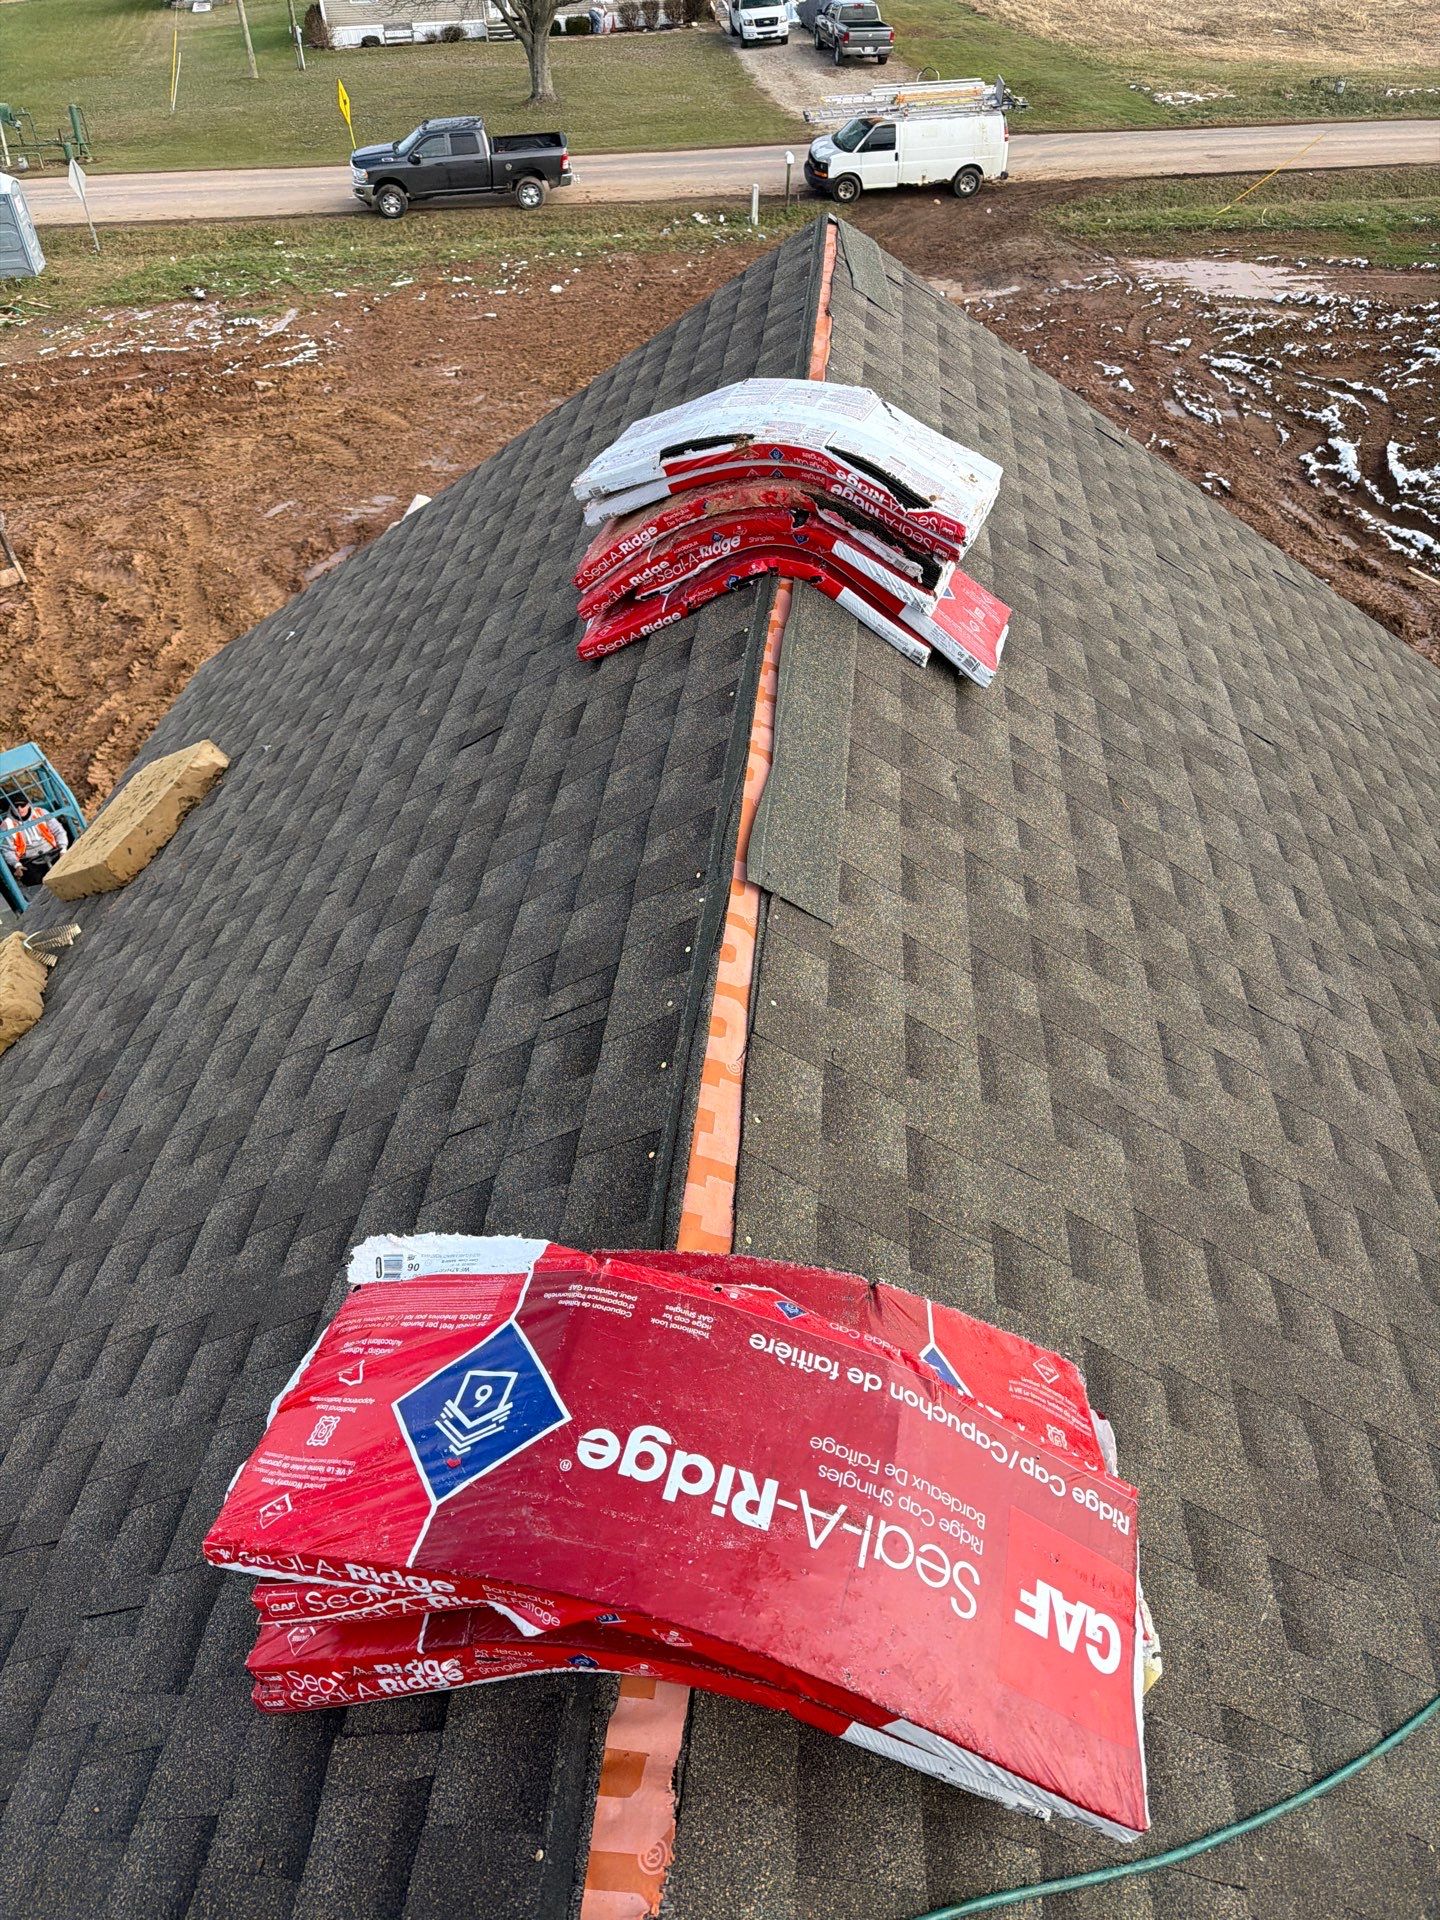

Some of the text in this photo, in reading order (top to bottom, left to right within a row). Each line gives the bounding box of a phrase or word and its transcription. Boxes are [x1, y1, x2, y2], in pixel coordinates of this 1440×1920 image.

[583, 525, 658, 581] Seal-A-Ridge
[656, 535, 741, 583] Seal-A-Ridge
[597, 611, 682, 655] Seal-A-Ridge
[408, 1263, 420, 1272] 06
[568, 1283, 638, 1302] pour bardeaux GAF
[581, 1301, 591, 1309] de
[586, 1292, 636, 1310] d'apparence
[591, 1303, 633, 1318] Capuchon
[661, 1312, 712, 1331] ridge cap for
[665, 1304, 714, 1323] GAF Shingles
[650, 1317, 710, 1339] Traditional Look
[748, 1332, 840, 1381] faîtière
[846, 1367, 882, 1393] de
[809, 1435, 987, 1531] Bardeaux De Faîtage
[818, 1465, 984, 1556] Ridge Cap Shingles
[1072, 1485, 1130, 1536] Ridge
[270, 1602, 297, 1612] GAF
[482, 1584, 556, 1608] Bardeaux
[486, 1592, 561, 1627] De Faîtage
[1015, 1579, 1122, 1675] GAF
